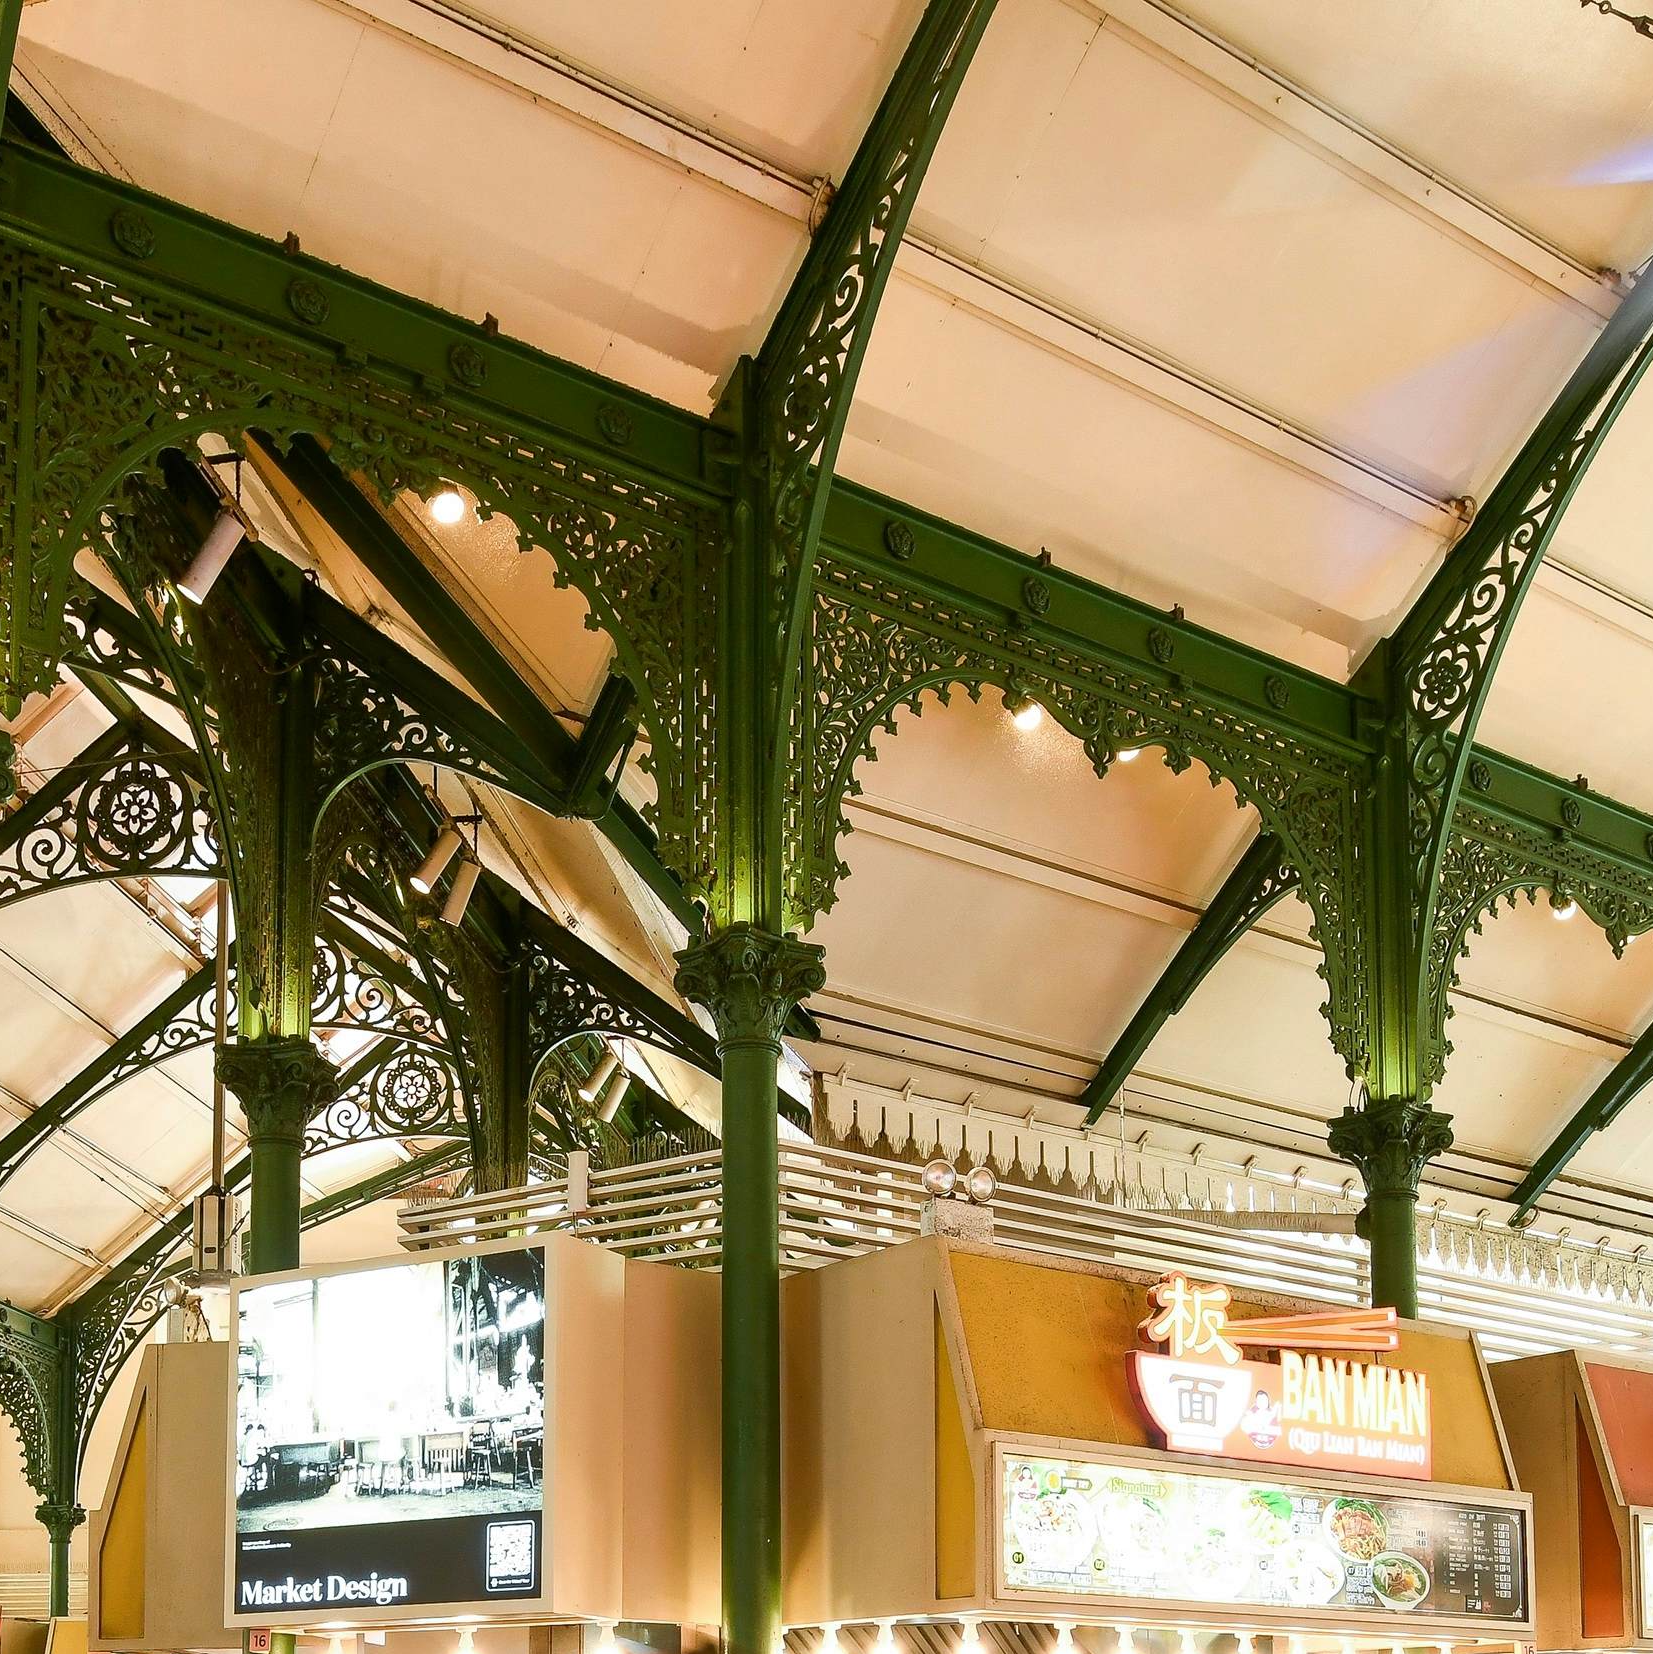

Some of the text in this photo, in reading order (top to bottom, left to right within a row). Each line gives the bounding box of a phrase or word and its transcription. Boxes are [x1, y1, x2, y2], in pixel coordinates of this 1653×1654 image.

[1280, 1350, 1427, 1437] BAN MIAN
[240, 1571, 408, 1606] Market Design
[253, 1634, 266, 1647] 16
